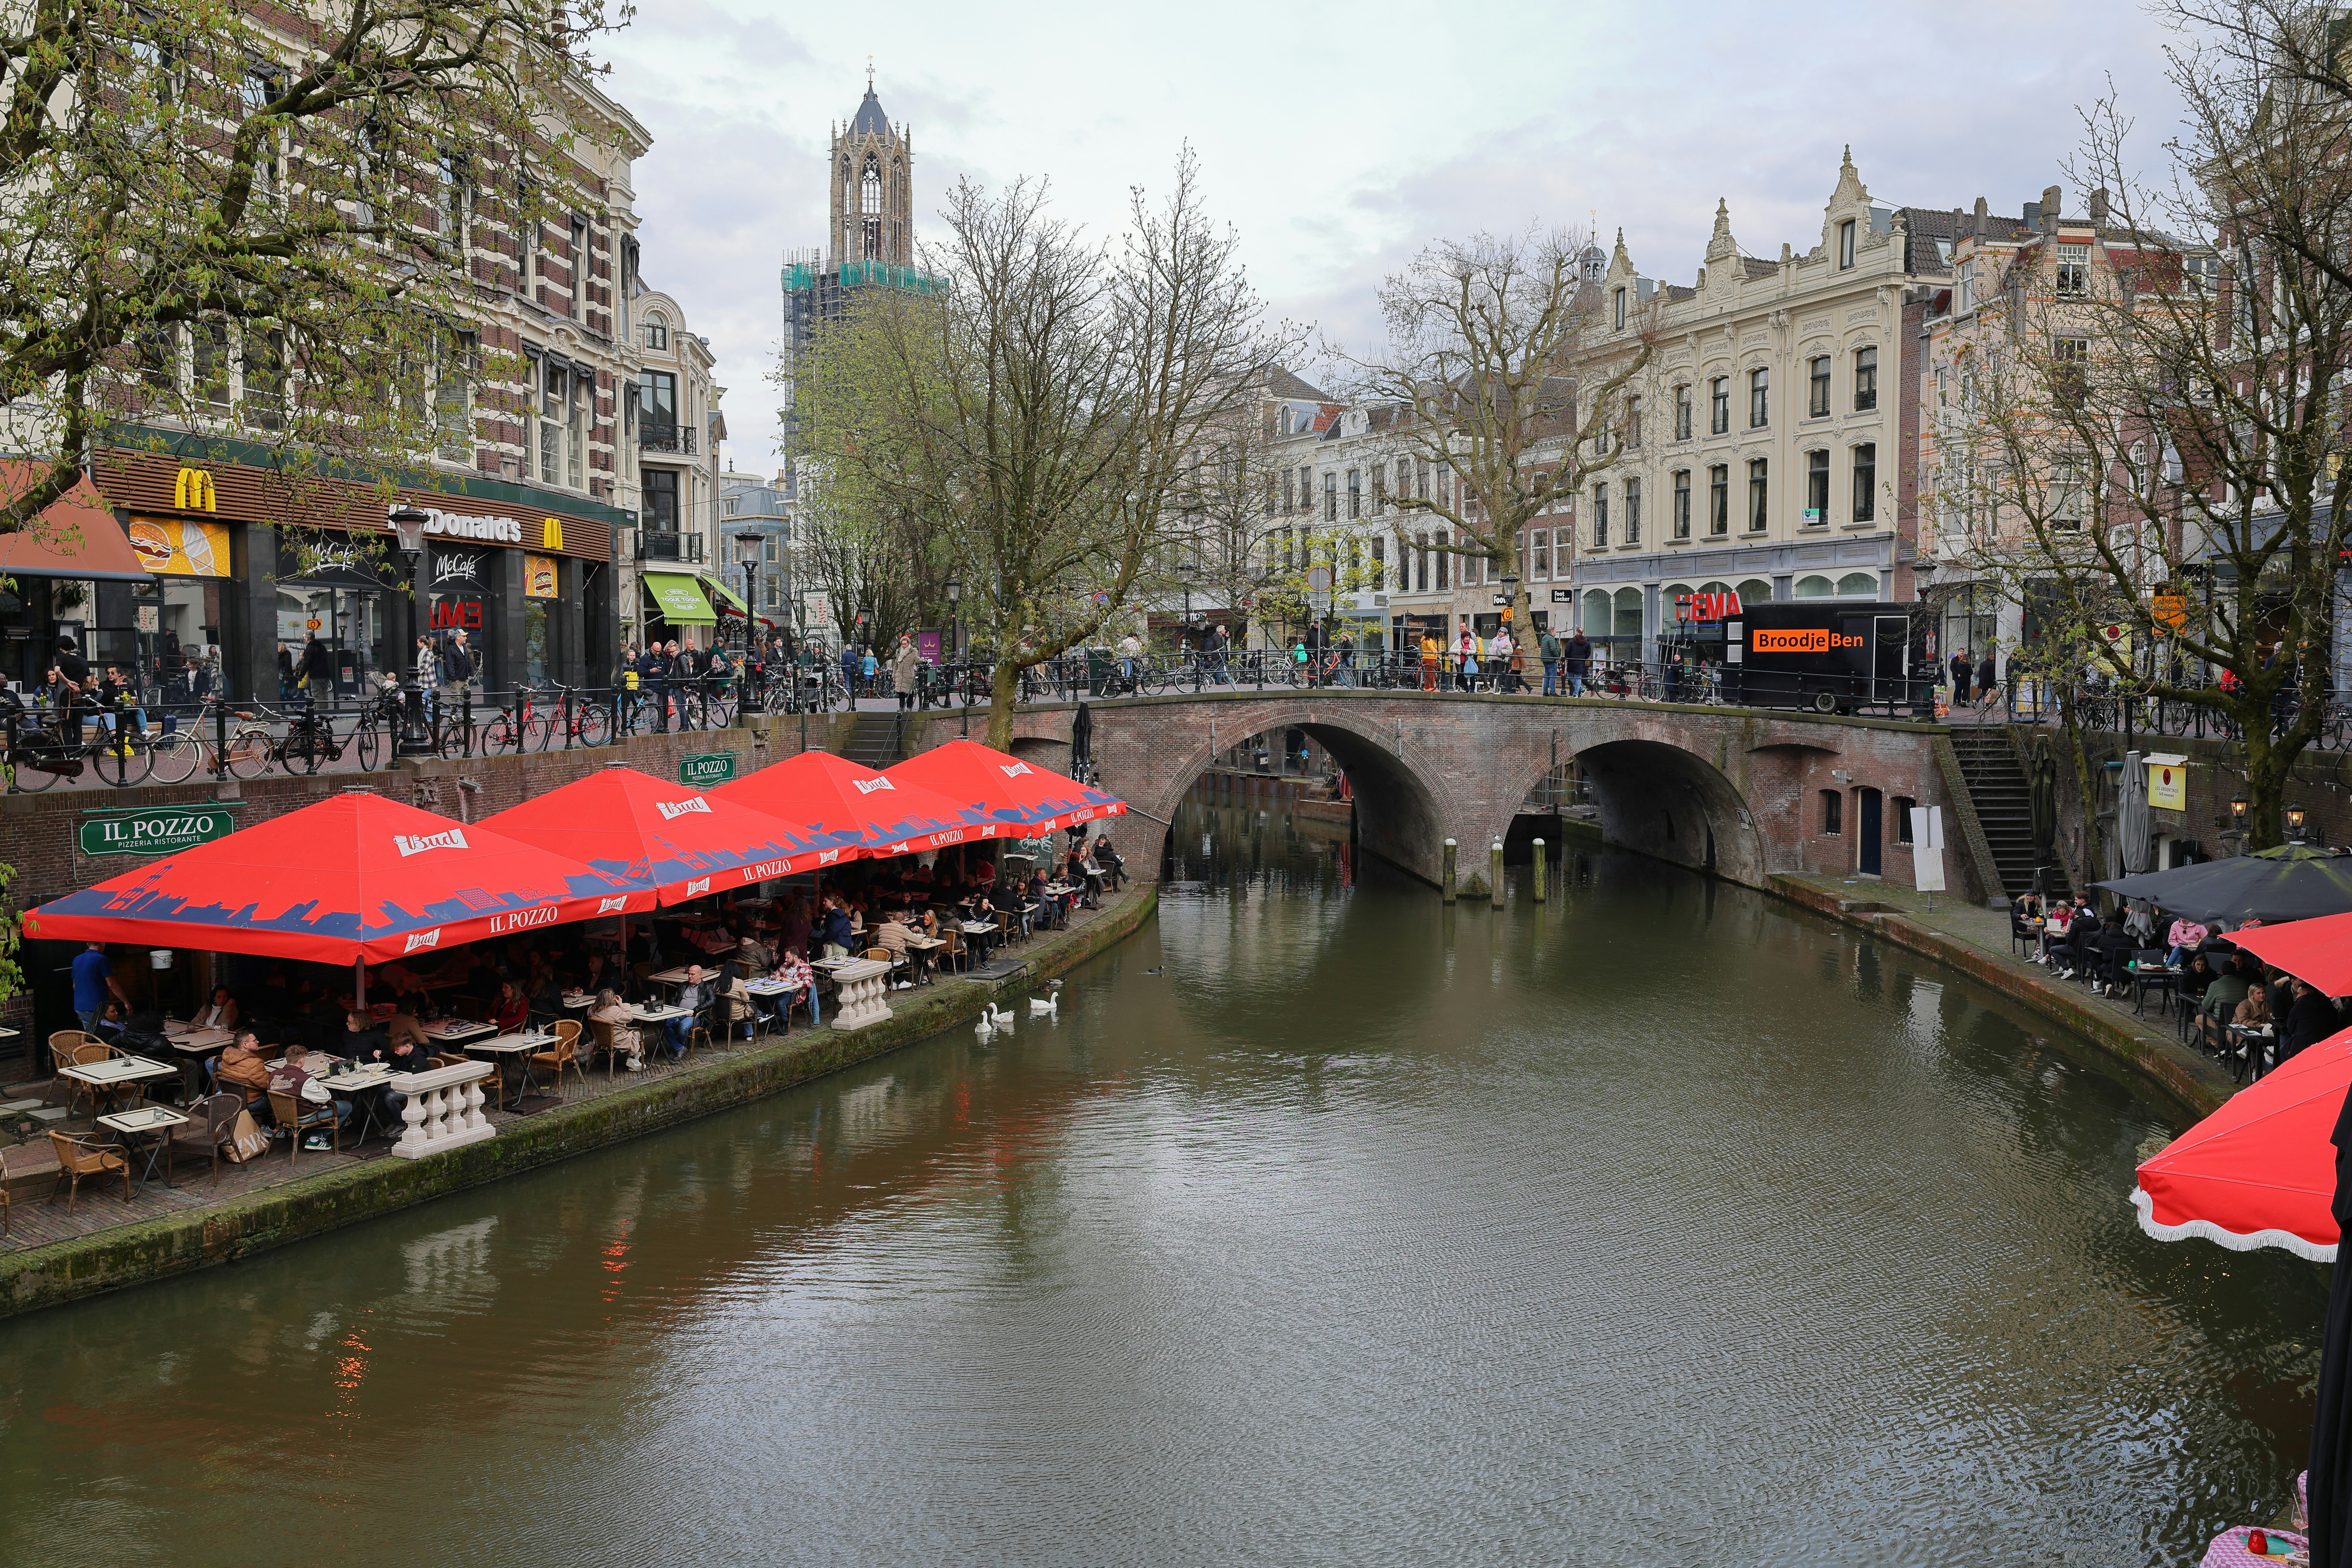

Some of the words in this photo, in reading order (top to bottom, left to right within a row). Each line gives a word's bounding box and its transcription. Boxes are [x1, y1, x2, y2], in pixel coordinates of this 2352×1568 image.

[436, 554, 475, 581] McCafé
[1759, 632, 1826, 650] Broodje
[1831, 633, 1863, 647] Ben
[687, 763, 697, 775] IL
[698, 760, 727, 775] POZZO
[852, 777, 889, 790] Bud
[655, 797, 704, 814] Bud
[1071, 813, 1078, 823] IL
[1076, 808, 1094, 821] POZZO
[103, 823, 128, 841] IL
[132, 816, 214, 838] POZZO
[118, 840, 152, 848] PIZZERIA
[155, 835, 201, 845] RISTORANTE
[393, 829, 459, 850] Bud
[929, 835, 940, 846] IL
[939, 829, 964, 844] POZZO
[742, 867, 757, 881] IL
[757, 859, 791, 878] POZZO
[490, 916, 507, 933] IL
[508, 906, 558, 930] POZZO
[407, 932, 436, 947] Bud
